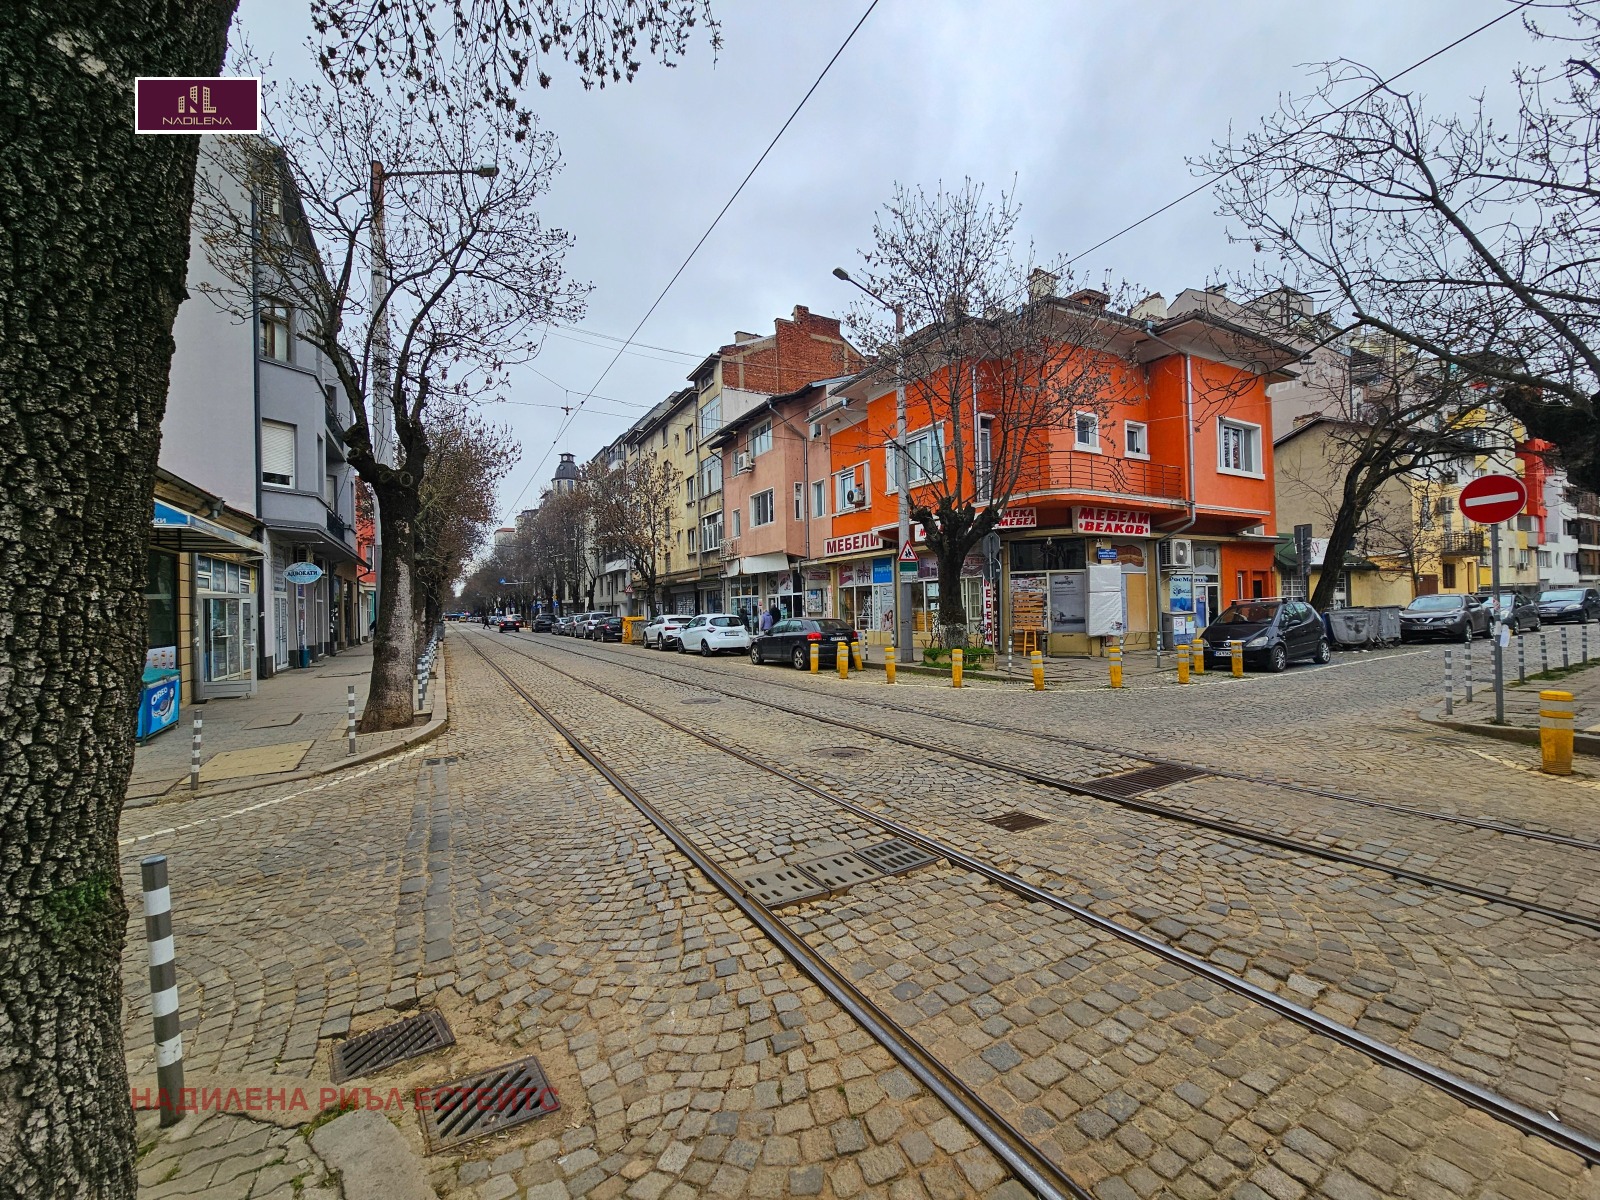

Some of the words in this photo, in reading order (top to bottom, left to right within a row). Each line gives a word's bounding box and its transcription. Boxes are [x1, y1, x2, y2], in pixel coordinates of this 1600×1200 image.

[998, 517, 1036, 527] МЕБЕЛ
[1078, 507, 1150, 525] МЕБЕЛИ
[1083, 521, 1145, 535] ВЕЛКОВ
[826, 533, 879, 554] МЕБЕЛИ
[150, 686, 169, 706] OREO
